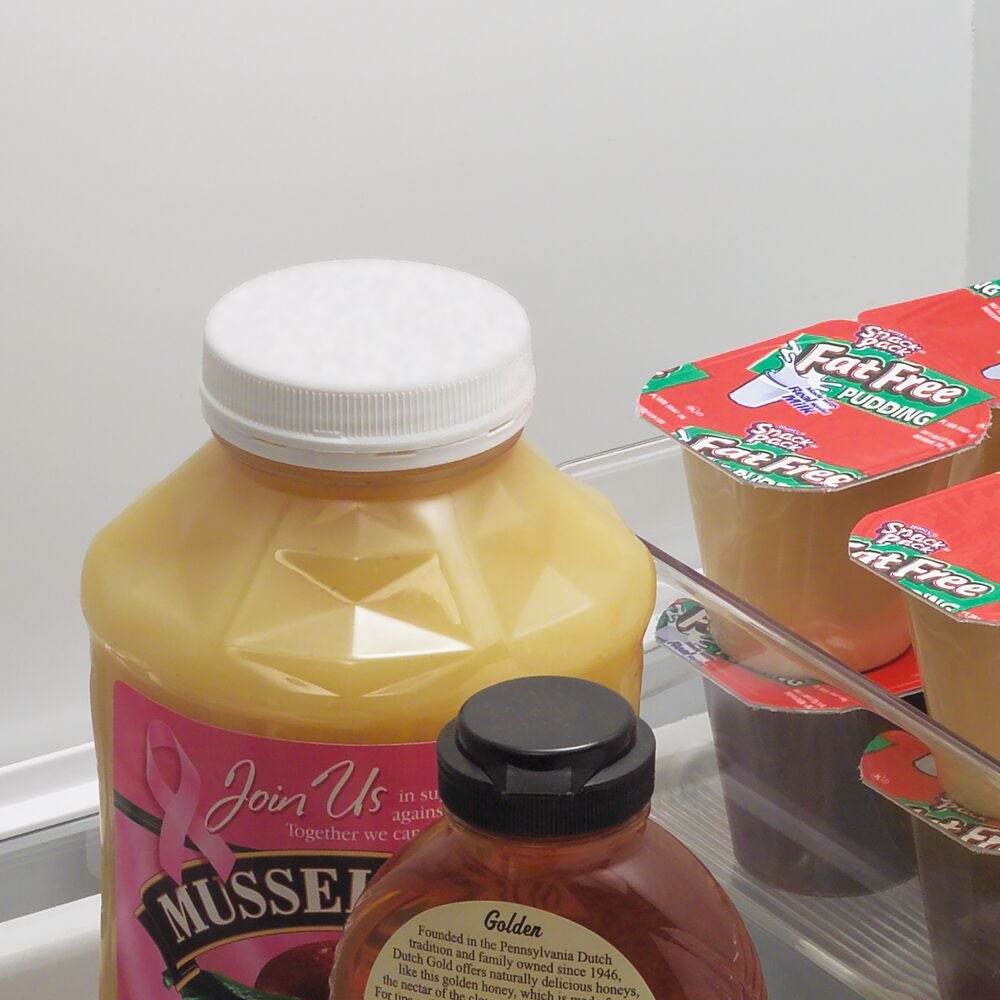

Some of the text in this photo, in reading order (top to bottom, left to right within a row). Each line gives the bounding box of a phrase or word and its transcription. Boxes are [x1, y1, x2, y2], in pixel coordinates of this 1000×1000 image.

[857, 336, 911, 358] Pack
[858, 326, 920, 351] Snack
[796, 343, 967, 406] Fat Free
[837, 388, 937, 426] PUDDING
[747, 433, 803, 452] Pack
[751, 422, 815, 449] Snack
[690, 435, 770, 467] Fat
[760, 456, 853, 490] Free
[877, 533, 935, 554] Pack
[882, 522, 950, 551] Snack
[889, 558, 989, 599] Free
[204, 759, 415, 834] Join Us in
[392, 806, 444, 825] agains
[286, 822, 359, 844] Together
[364, 828, 389, 842] we
[157, 867, 373, 943] MUSSEL
[483, 909, 543, 938] Golden
[418, 924, 613, 966] Founded in the Pennsylvania Dutch
[393, 947, 641, 1000] Dutch Gold offers naturally delicious honeys,
[409, 939, 622, 983] tradition and family owned since 1946,
[375, 986, 393, 1000] For
[382, 974, 398, 988] the
[400, 981, 433, 996] nectar
[434, 987, 448, 999] of
[399, 963, 418, 979] like
[420, 969, 440, 983] this
[441, 976, 479, 990] golden
[481, 981, 518, 1000] honey,
